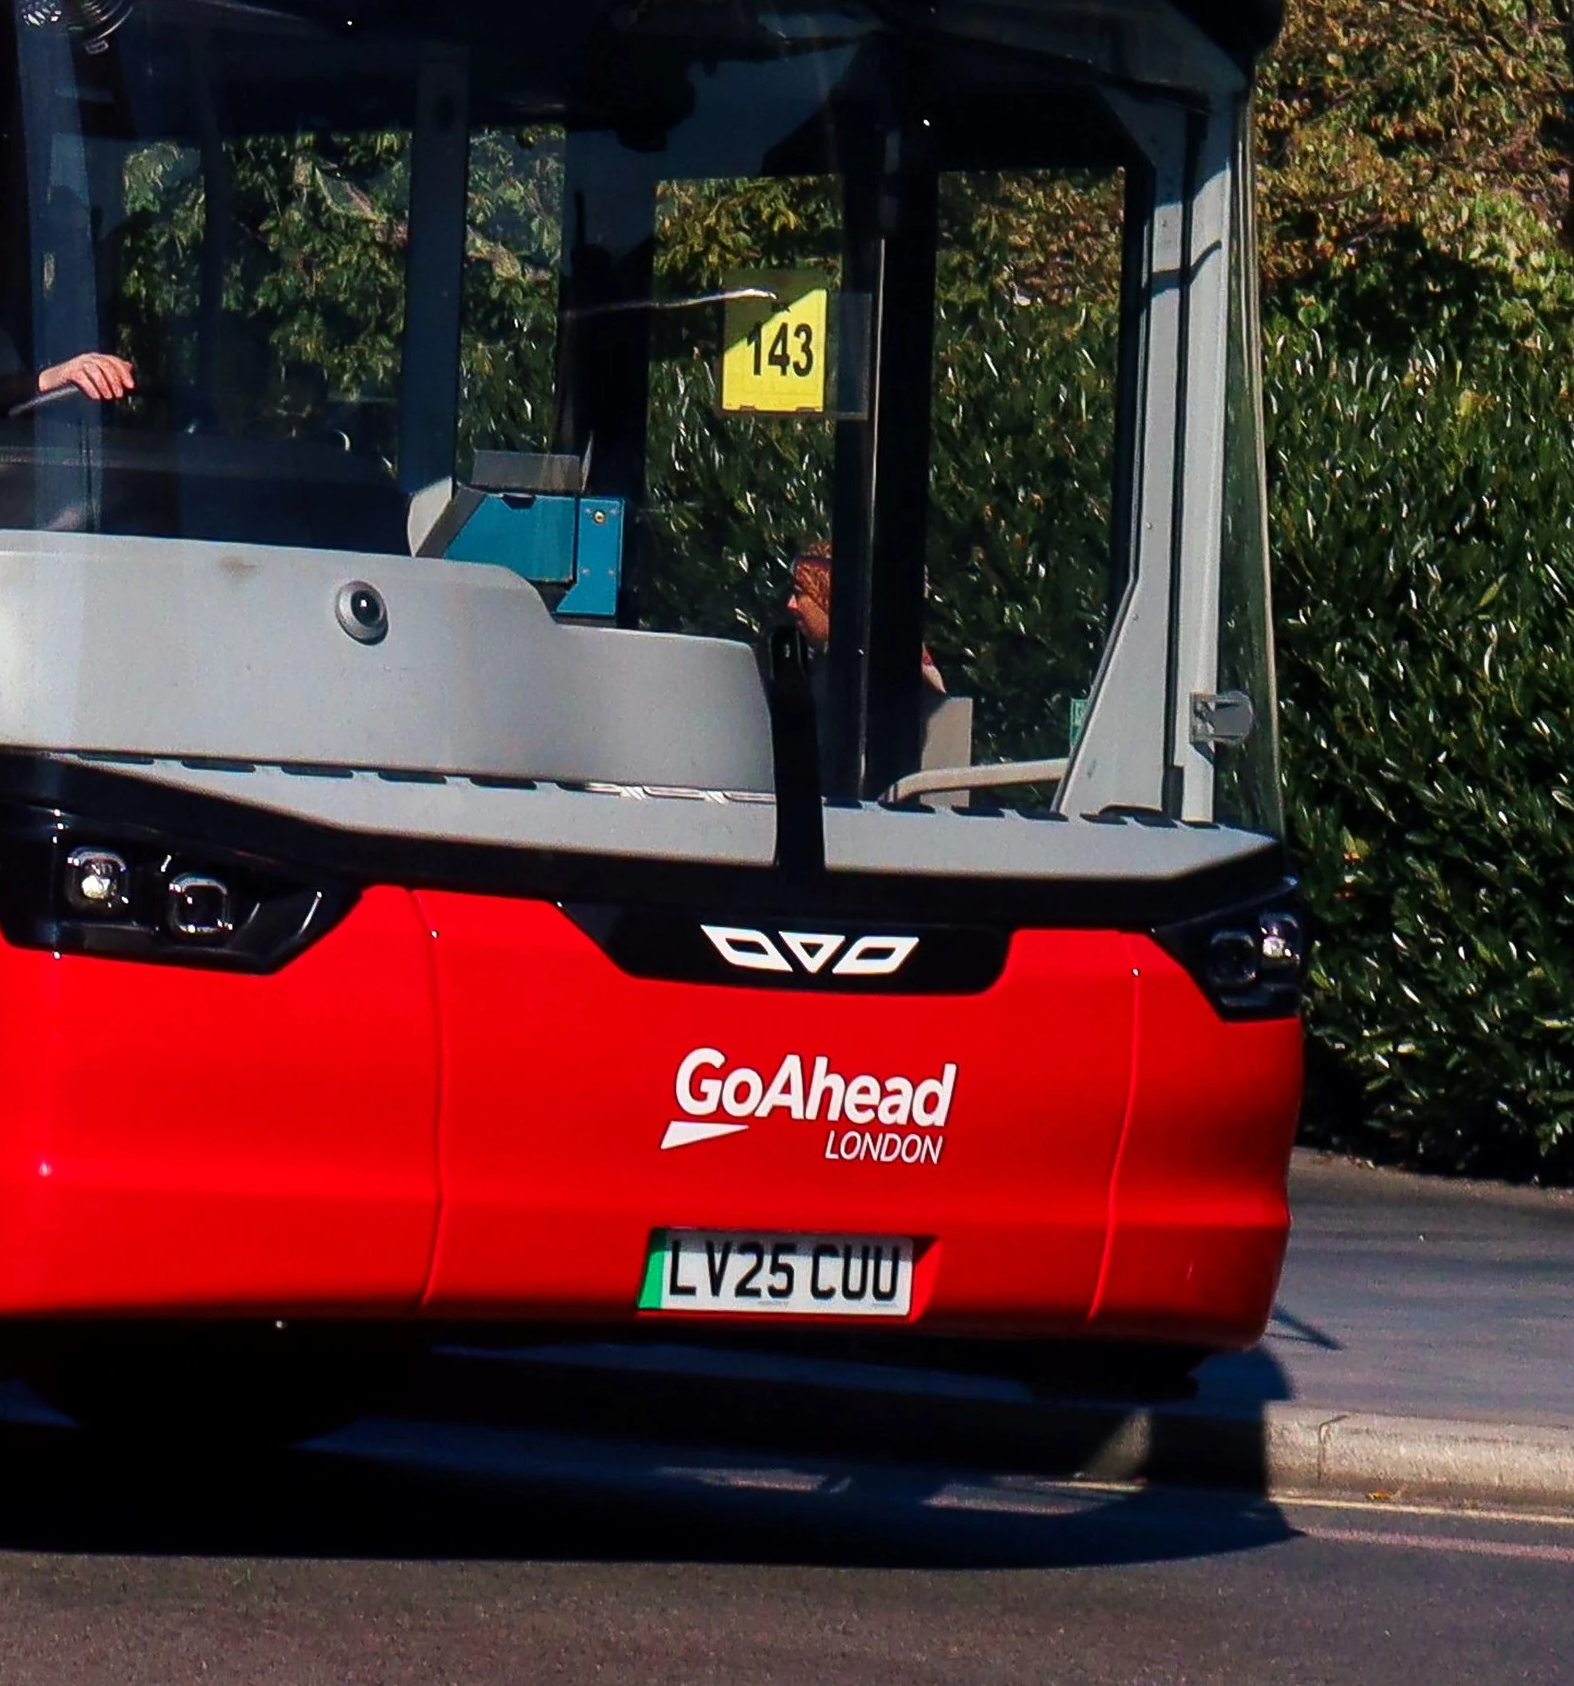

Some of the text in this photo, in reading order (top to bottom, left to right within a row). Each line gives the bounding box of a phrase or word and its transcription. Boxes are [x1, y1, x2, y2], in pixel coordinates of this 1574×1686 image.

[747, 321, 814, 377] 143
[824, 1129, 944, 1165] LONDON
[668, 1239, 902, 1303] LV25 CUU
